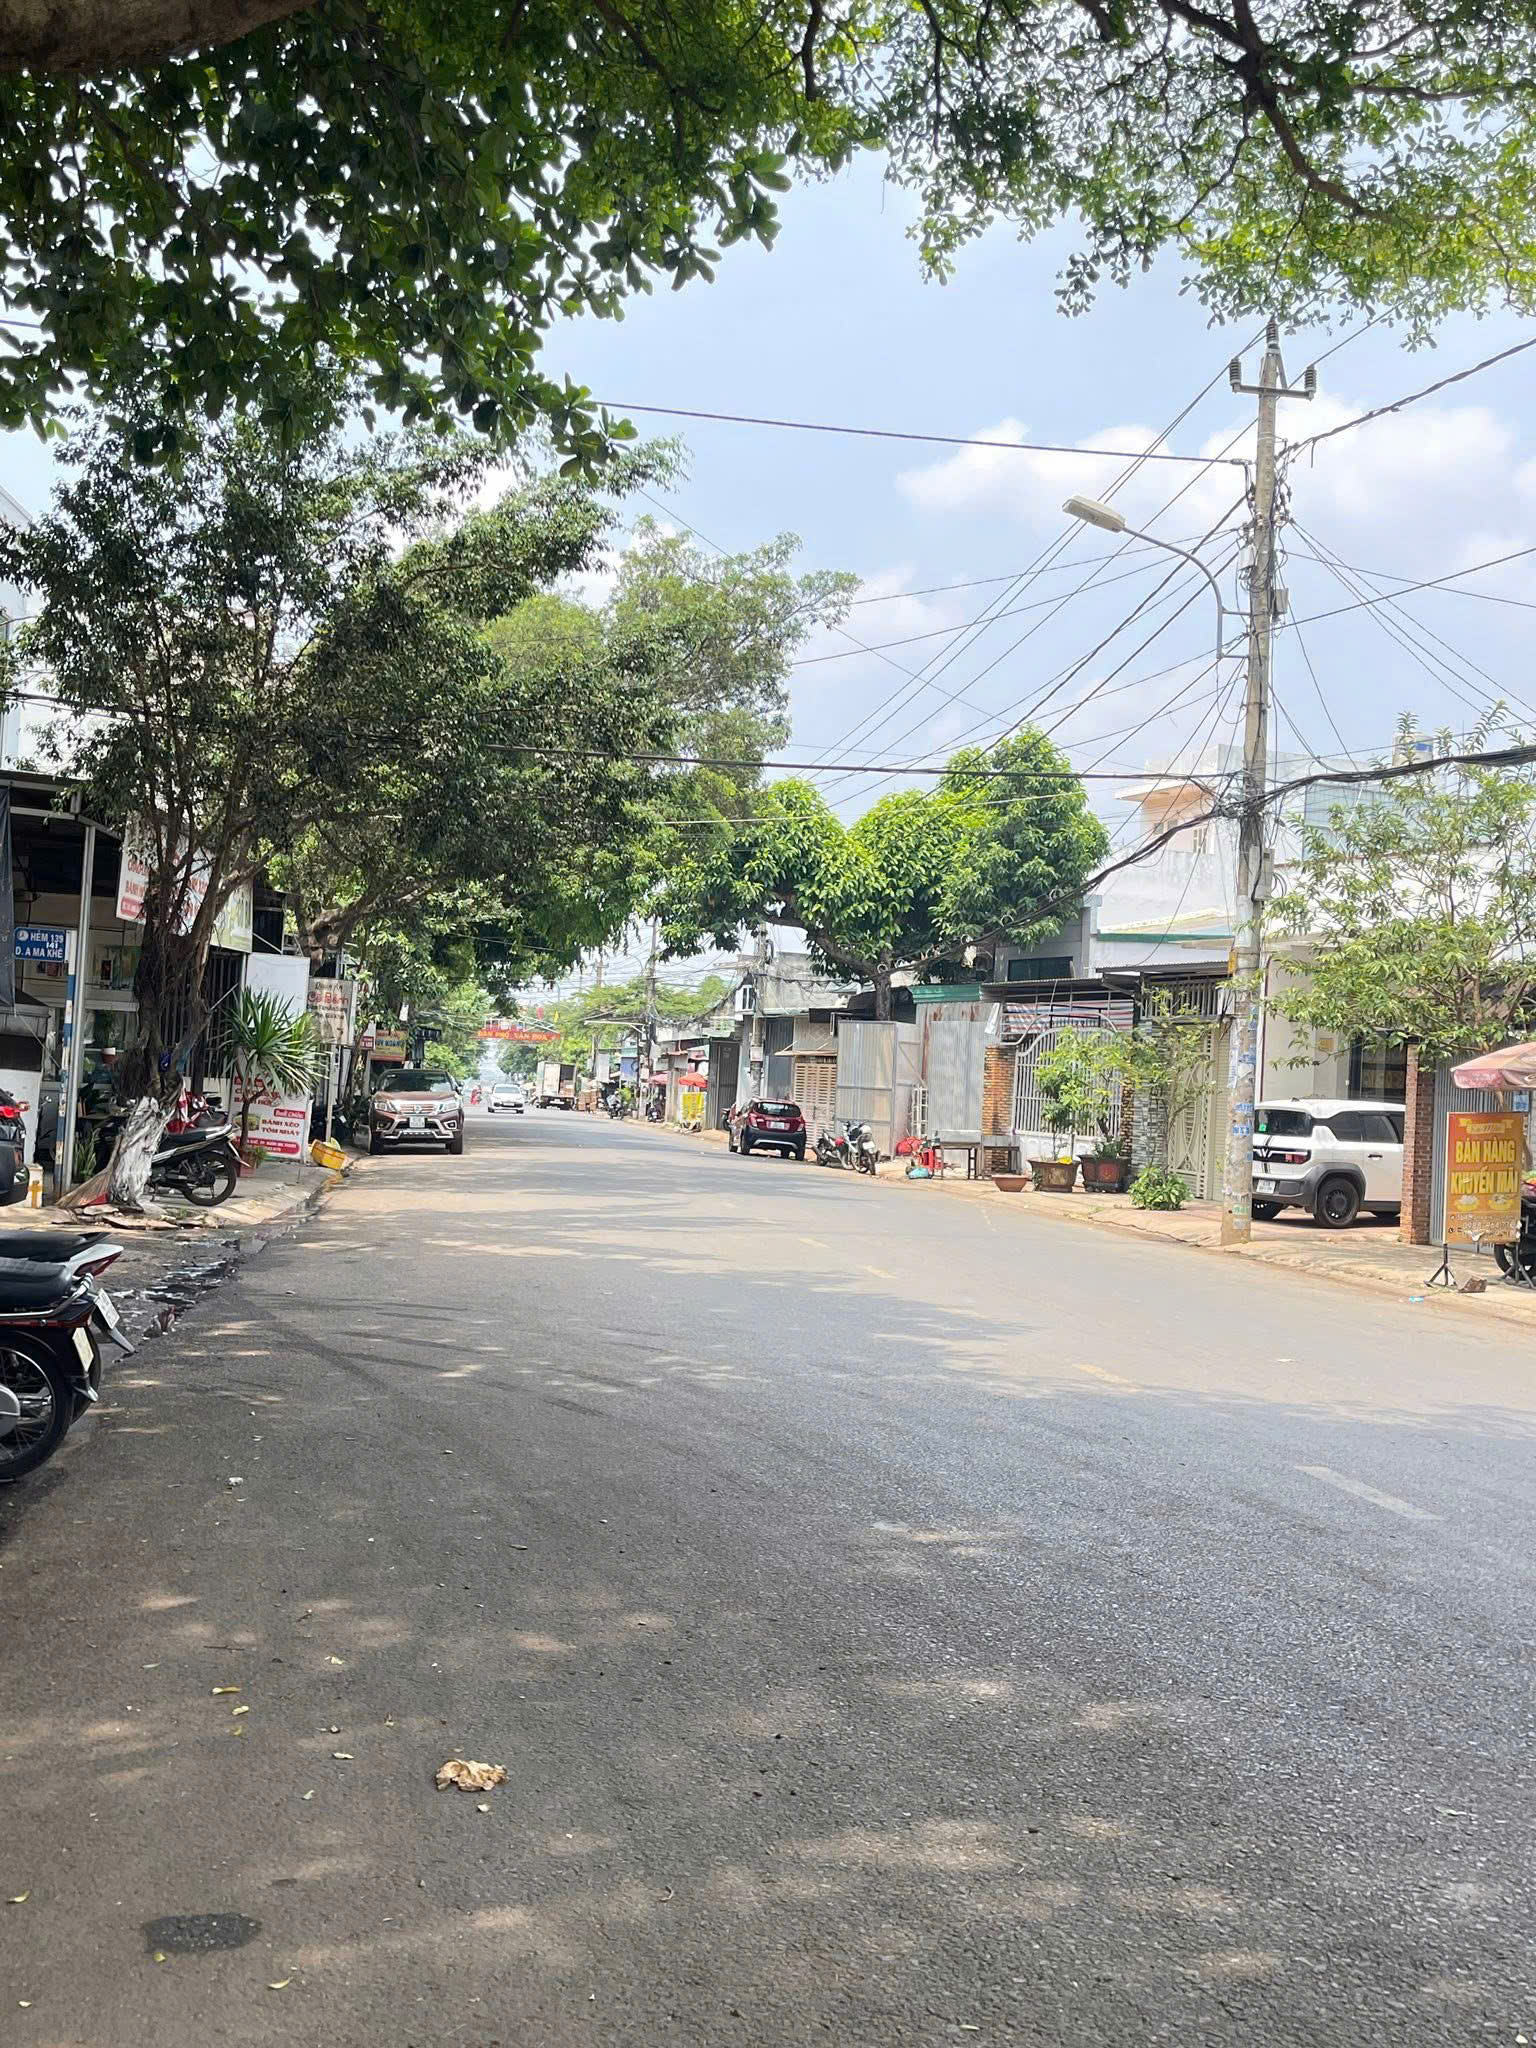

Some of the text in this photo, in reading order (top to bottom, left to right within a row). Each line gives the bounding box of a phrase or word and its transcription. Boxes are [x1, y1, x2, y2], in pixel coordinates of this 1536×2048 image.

[1455, 1136, 1516, 1163] BÁN HÀNG
[1451, 1165, 1494, 1194] KHUYẾN
